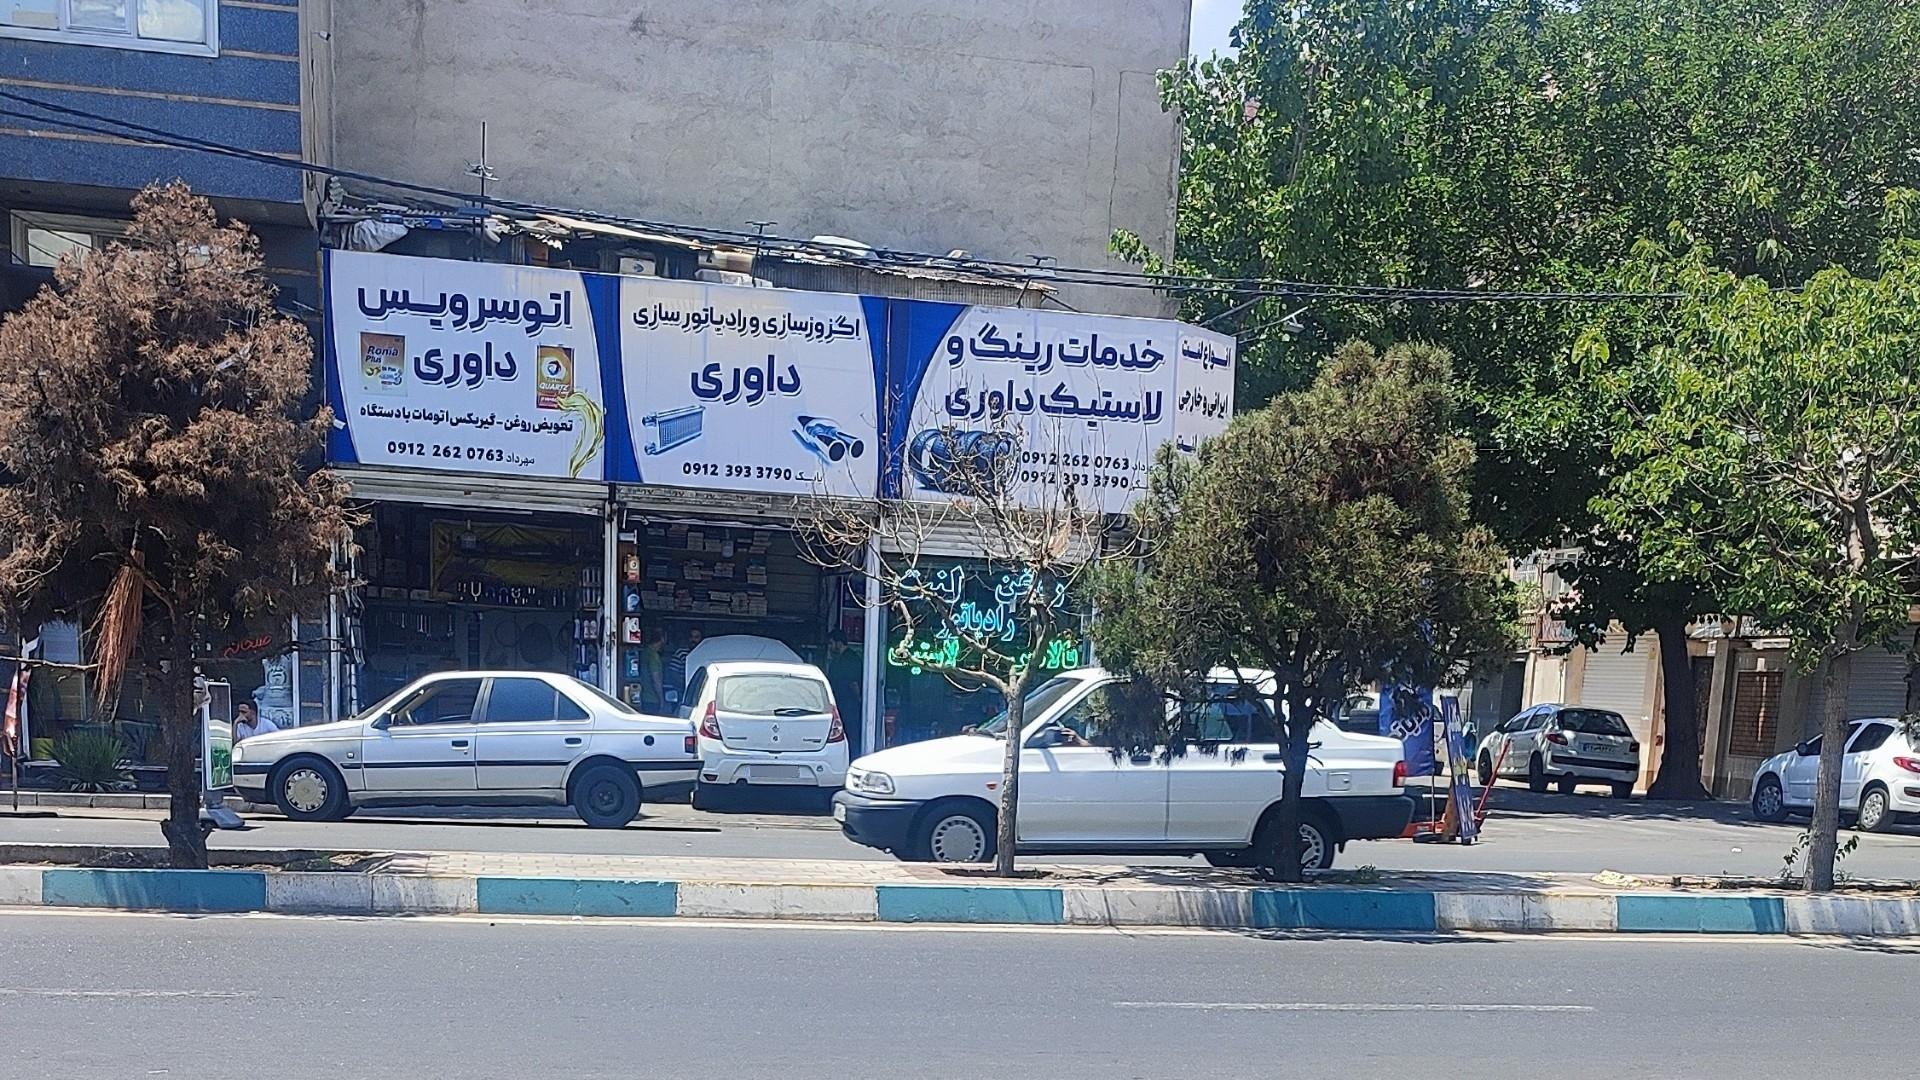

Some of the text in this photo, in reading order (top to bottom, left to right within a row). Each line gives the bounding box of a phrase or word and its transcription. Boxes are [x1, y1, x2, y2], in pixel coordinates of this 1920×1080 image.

[633, 303, 680, 328] سازی
[683, 307, 746, 334] رادیاتور
[749, 315, 760, 335] و
[367, 345, 399, 357] Ronia
[947, 322, 1165, 372] خدمات رینگ و
[365, 354, 382, 363] Plus
[413, 342, 518, 386] داوری
[691, 355, 801, 402] داوری
[945, 379, 1163, 427] لاستیک داوری
[1178, 386, 1229, 418] ایرانی و خارجی
[412, 408, 448, 424] اتومات
[450, 412, 496, 429] گیربکس
[504, 414, 531, 433] روغن
[532, 417, 573, 435] تعویض
[388, 441, 535, 467] 0912 262 0763 مهرداد
[1021, 451, 1057, 466] 0912
[1062, 453, 1090, 467] 262
[1094, 456, 1129, 471] 0763
[682, 462, 719, 476] 0912
[725, 465, 752, 478] 393
[756, 466, 792, 481] 3790
[1063, 472, 1089, 486] 393
[1093, 474, 1129, 488] 3790
[893, 565, 965, 603] لنت
[224, 634, 272, 659] صبحانه
